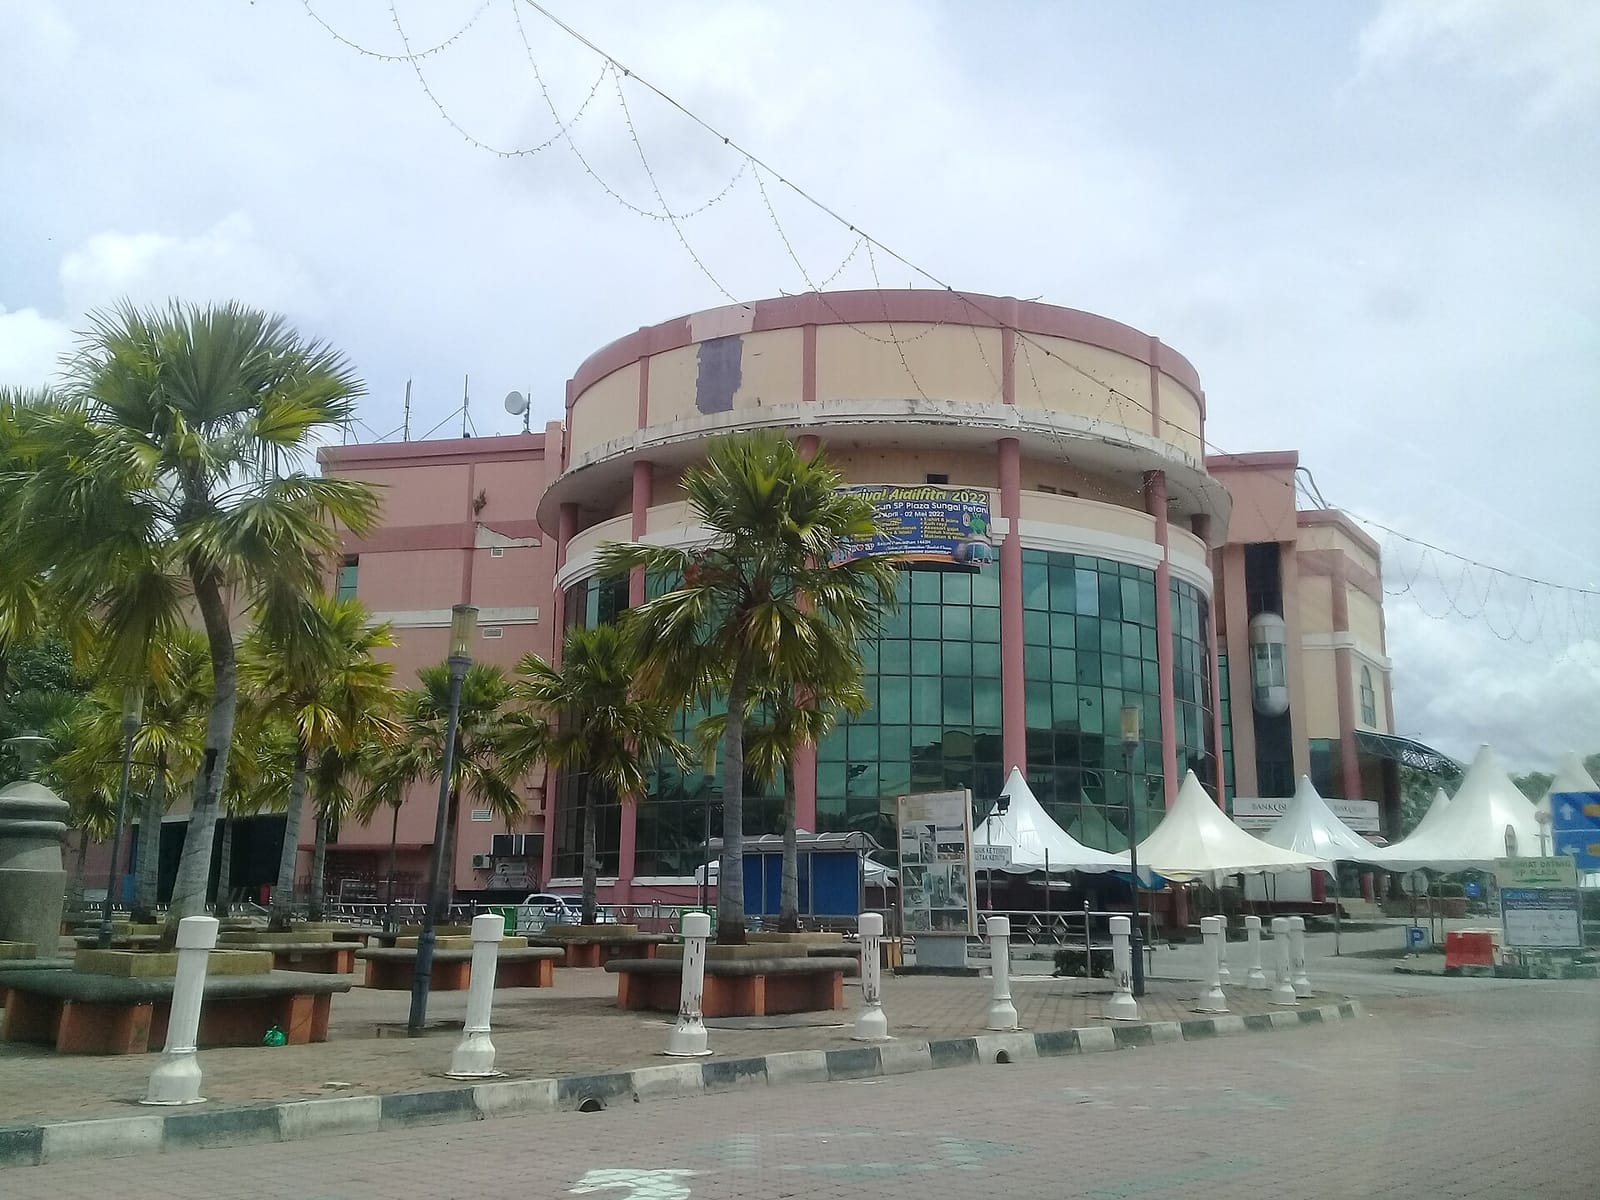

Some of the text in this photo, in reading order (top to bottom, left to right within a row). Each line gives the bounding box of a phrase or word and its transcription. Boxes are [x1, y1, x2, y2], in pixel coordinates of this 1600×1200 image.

[889, 488, 947, 500] Aidilfitri
[952, 491, 987, 505] 2022
[906, 502, 930, 510] Plaza
[931, 502, 960, 511] Sungai
[1410, 929, 1425, 945] P
